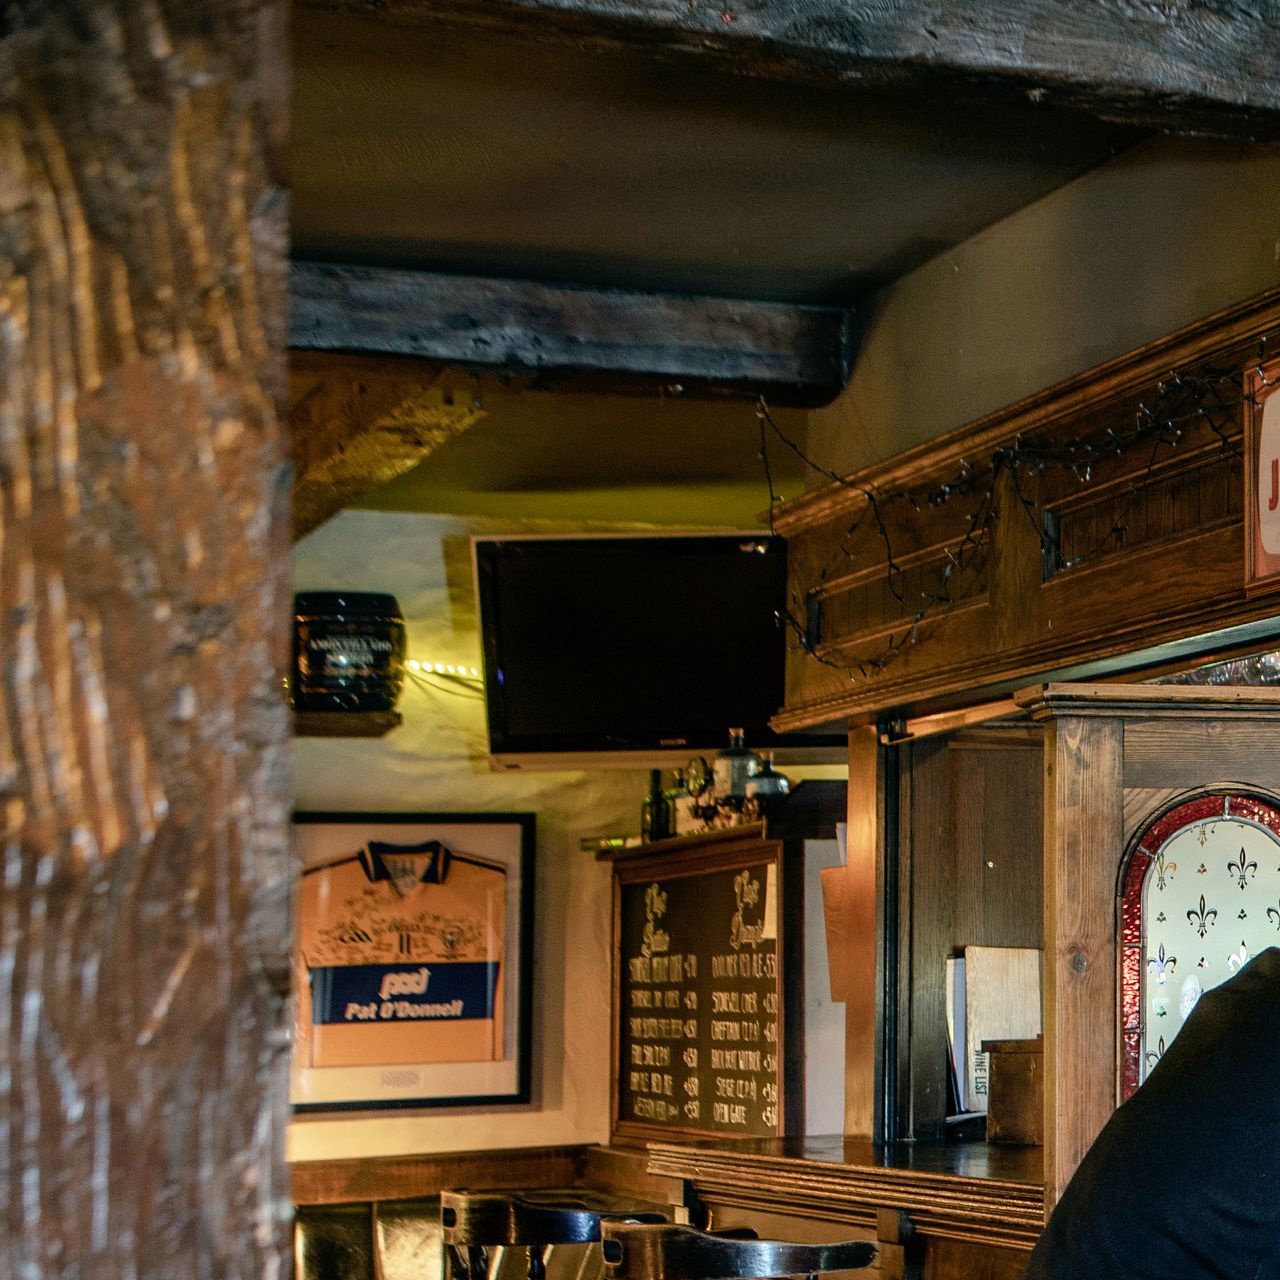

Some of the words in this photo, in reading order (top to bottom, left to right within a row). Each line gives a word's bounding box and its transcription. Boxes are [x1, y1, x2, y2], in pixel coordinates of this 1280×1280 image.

[345, 1002, 378, 1020] Pat
[380, 999, 464, 1019] O'Donnell
[974, 1049, 987, 1073] WINE
[975, 1076, 987, 1096] LIST
